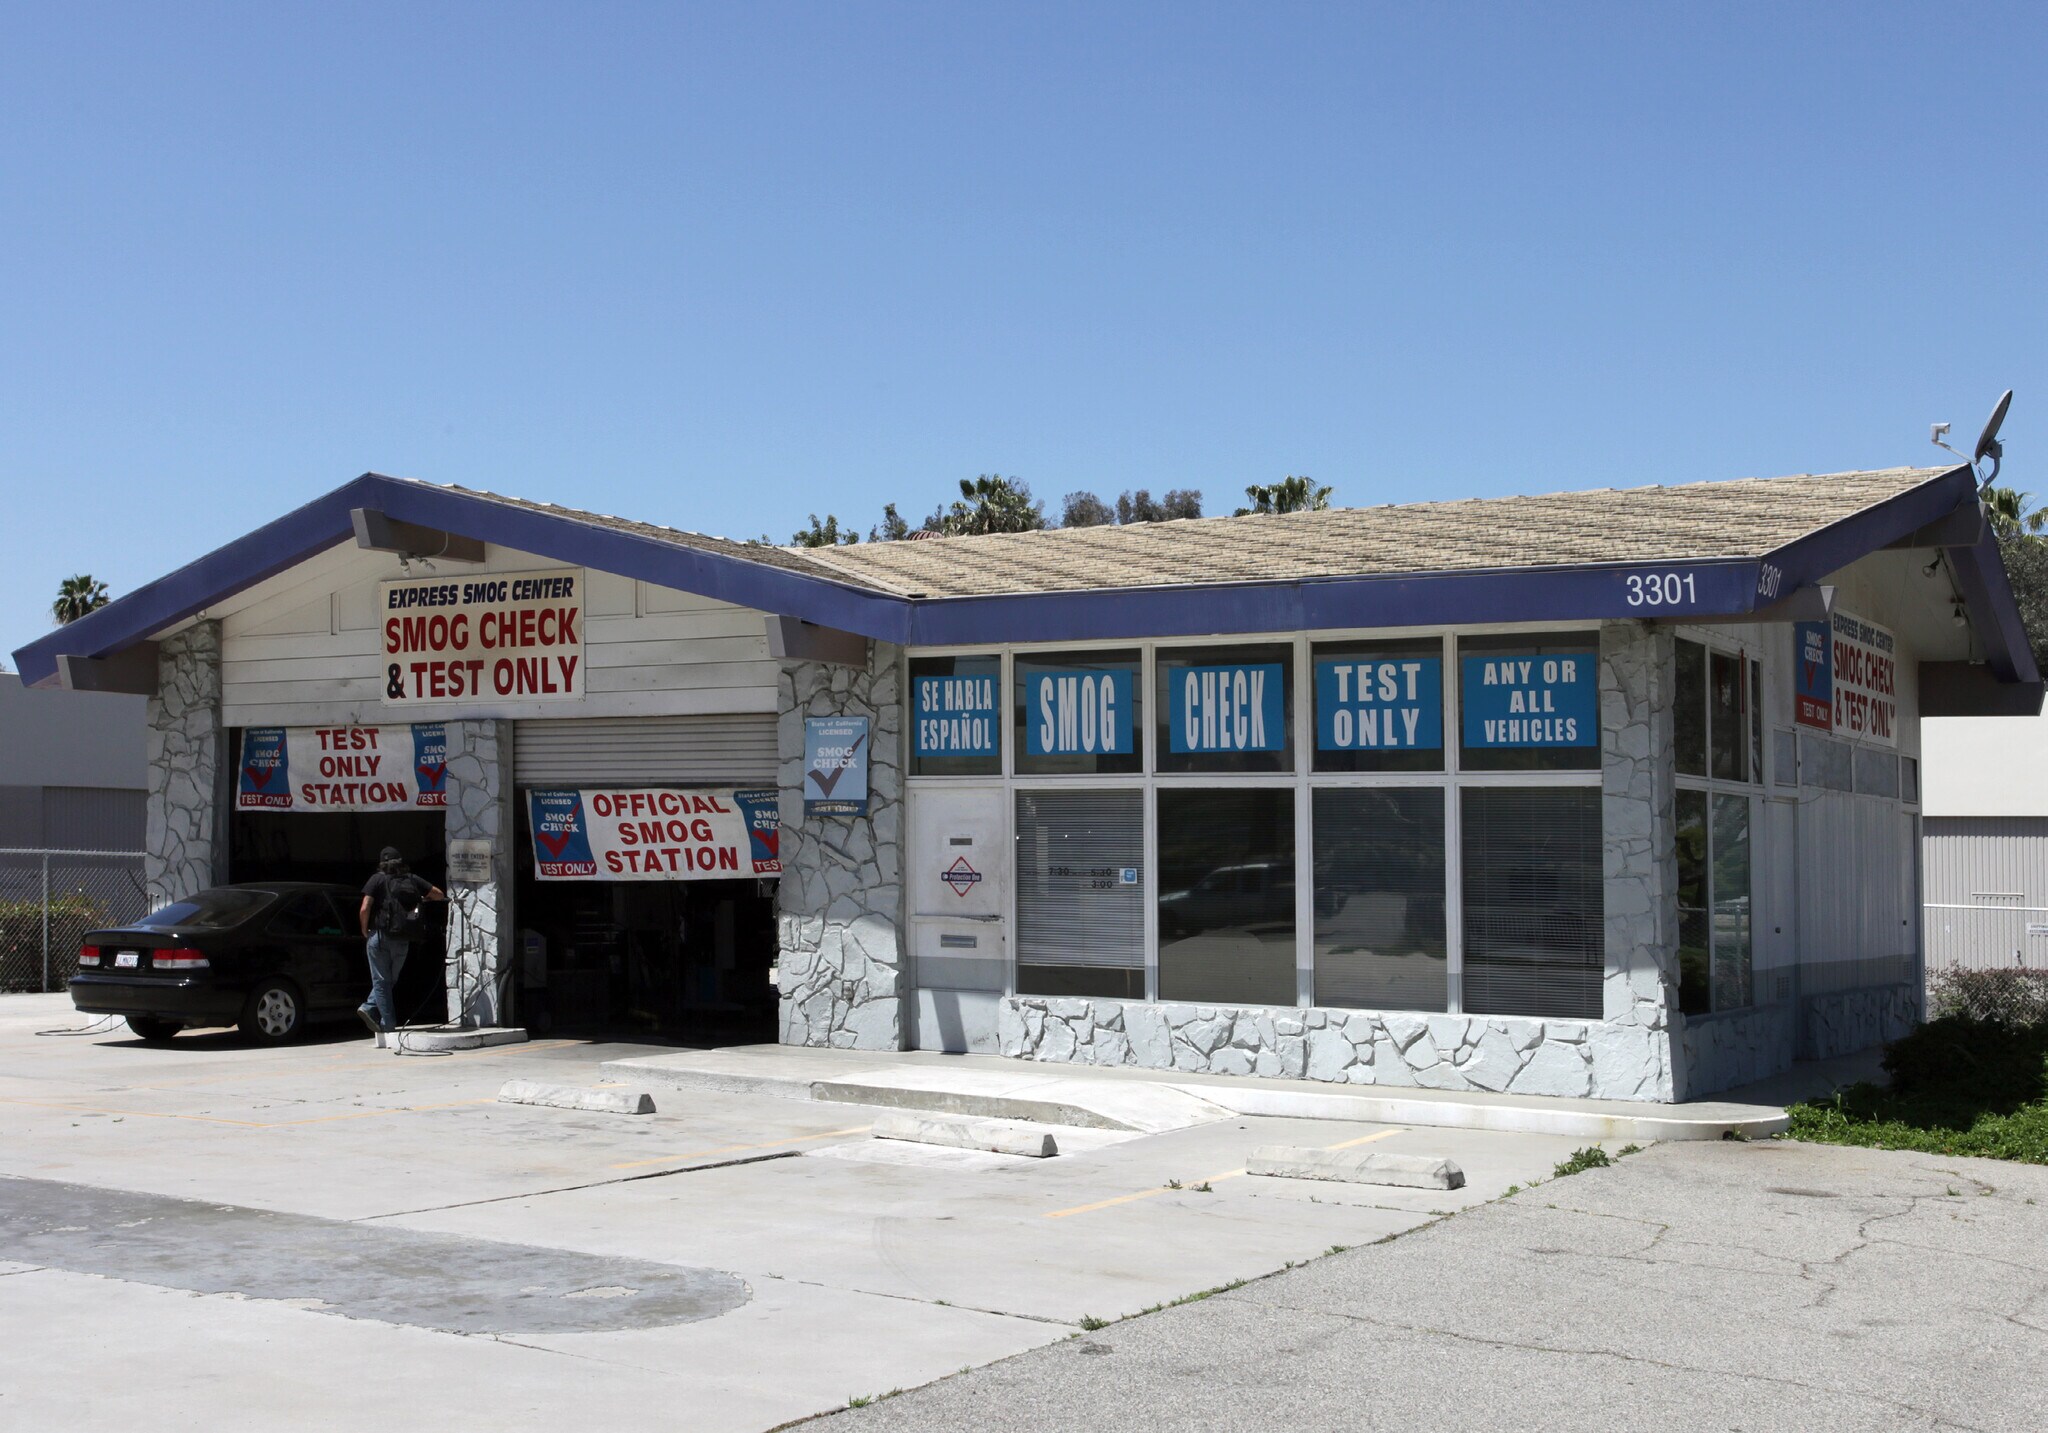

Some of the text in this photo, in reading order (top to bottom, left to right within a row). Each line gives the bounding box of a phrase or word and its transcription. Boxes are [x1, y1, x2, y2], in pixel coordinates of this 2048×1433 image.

[1626, 573, 1696, 606] 3301
[1758, 563, 1782, 599] 3301
[388, 577, 574, 609] EXPRESS SMOG CENTER
[386, 607, 578, 654] SMOG CHECK
[1806, 630, 1823, 647] SMOG
[1833, 612, 1894, 654] EXPRESS SMOG CENTER
[1804, 646, 1824, 665] CHECK
[386, 655, 578, 699] & TEST ONLY
[1484, 660, 1576, 685] ANY OR
[1833, 640, 1895, 697] SMOG CHECK
[1334, 663, 1421, 702] TEST
[922, 679, 992, 712] SE HABLA
[1509, 690, 1555, 713] ALL
[1040, 674, 1116, 753] SMOG
[1185, 669, 1266, 750] CHECK
[1803, 701, 1828, 721] TEST ONLY
[1835, 687, 1895, 738] & TEST ONLY
[920, 712, 991, 750] ESPAÑOL
[1334, 708, 1419, 747] ONLY
[1484, 718, 1577, 742] VEHICLES
[315, 728, 379, 750] TEST
[424, 745, 446, 754] SMO
[255, 749, 280, 758] SMOG
[420, 755, 447, 764] CHE
[813, 758, 857, 768] CHECK
[817, 747, 854, 757] SMOG
[249, 759, 281, 768] CHECK
[319, 756, 381, 778] ONLY
[241, 794, 292, 806] TEST ONLY
[301, 782, 408, 804] STATION
[419, 794, 439, 804] TEST
[593, 793, 731, 817] OFFICIAL
[754, 810, 778, 820] SMO
[541, 823, 579, 832] CHECK
[545, 813, 574, 822] SMOG
[618, 819, 714, 845] SMOG
[541, 863, 595, 875] TEST ONLY
[605, 846, 738, 873] STATION
[950, 873, 972, 881] Protection
[1048, 867, 1070, 876] 7:30
[1092, 880, 1113, 889] 3:00
